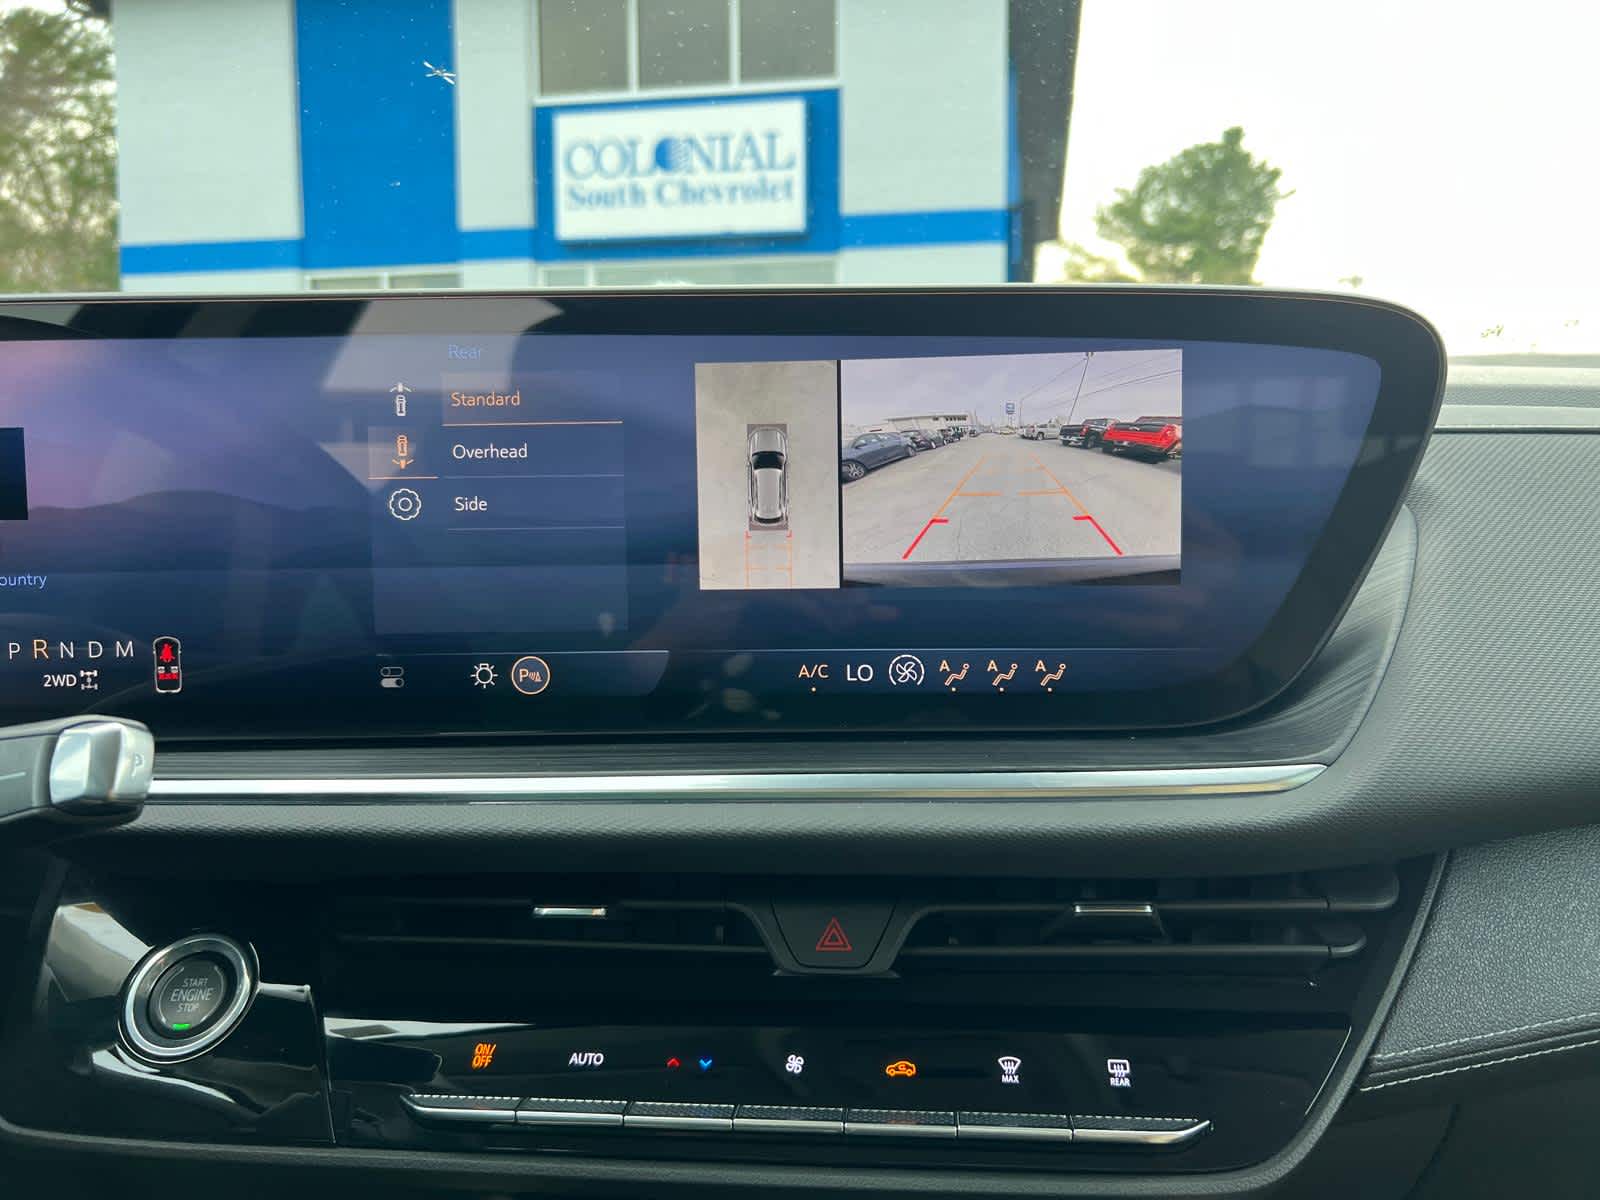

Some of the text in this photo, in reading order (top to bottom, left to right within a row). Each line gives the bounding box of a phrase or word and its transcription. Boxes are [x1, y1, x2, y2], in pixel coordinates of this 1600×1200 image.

[563, 129, 796, 179] COLONIAL
[566, 175, 794, 210] South Chevrolet
[448, 344, 483, 360] Rear
[450, 390, 521, 407] Standard
[452, 443, 528, 459] Overhead
[454, 496, 488, 512] Side
[8, 639, 134, 660] P R N D M
[798, 664, 829, 678] A/C
[846, 664, 874, 682] LO
[43, 674, 77, 687] 2WD
[182, 978, 208, 987] START
[170, 988, 214, 1002] ENGINE
[177, 1003, 200, 1013] STOP
[475, 1043, 496, 1056] ON/
[472, 1056, 492, 1068] OFF
[568, 1052, 605, 1067] AUTO
[1001, 1074, 1020, 1084] MAX
[1109, 1077, 1131, 1087] REAR
